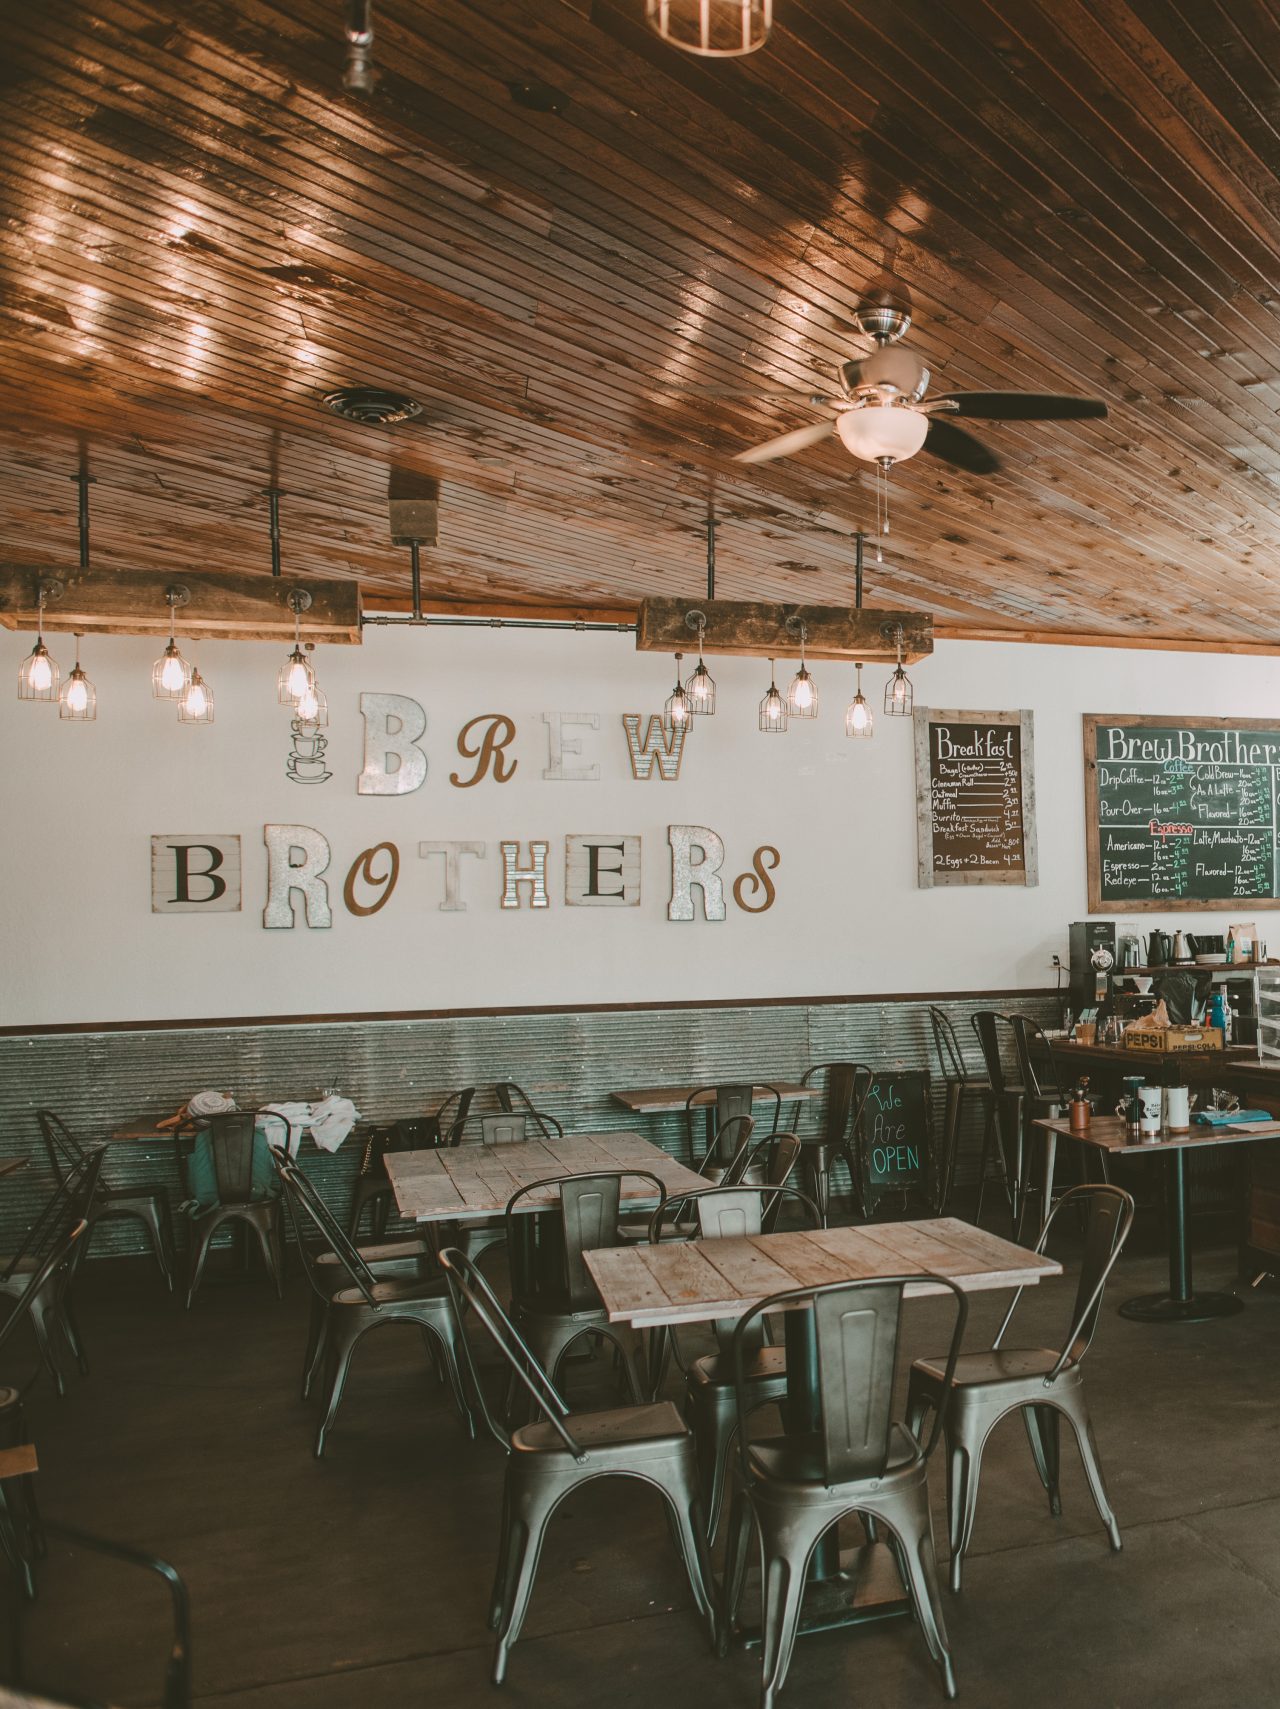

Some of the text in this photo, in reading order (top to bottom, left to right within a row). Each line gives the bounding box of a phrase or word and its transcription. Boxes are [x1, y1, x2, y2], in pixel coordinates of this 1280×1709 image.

[357, 692, 687, 796] BREW
[935, 728, 1013, 759] Breakfast
[1107, 728, 1172, 760] Brew
[940, 763, 960, 776] Bagel
[1164, 760, 1194, 772] Coffee
[1197, 765, 1214, 780] Cold
[1215, 766, 1234, 779] Brew
[1120, 768, 1145, 784] Coffee
[932, 788, 958, 799] Oatmeal
[1196, 784, 1206, 795] As
[1207, 784, 1213, 795] A
[1215, 783, 1234, 796] Latte
[932, 798, 956, 810] Muffin
[1100, 800, 1143, 816] Pour-Over
[1198, 802, 1230, 819] Flavored
[932, 811, 960, 821] Burrito
[933, 823, 968, 833] Breakfast
[969, 824, 1000, 833] Sandwich
[1150, 821, 1193, 843] Espresso
[1106, 833, 1146, 851] Americano
[934, 854, 945, 865] 2
[946, 854, 962, 868] Eggs
[970, 854, 979, 864] 2
[980, 855, 1000, 865] Bacon
[1104, 860, 1140, 875] Espresso
[1195, 862, 1227, 876] Flavored
[166, 823, 781, 929] BROTHERS
[1126, 1032, 1163, 1049] PEPSI
[868, 1085, 902, 1111] We
[871, 1113, 906, 1144] Are
[873, 1144, 919, 1174] OPEN
